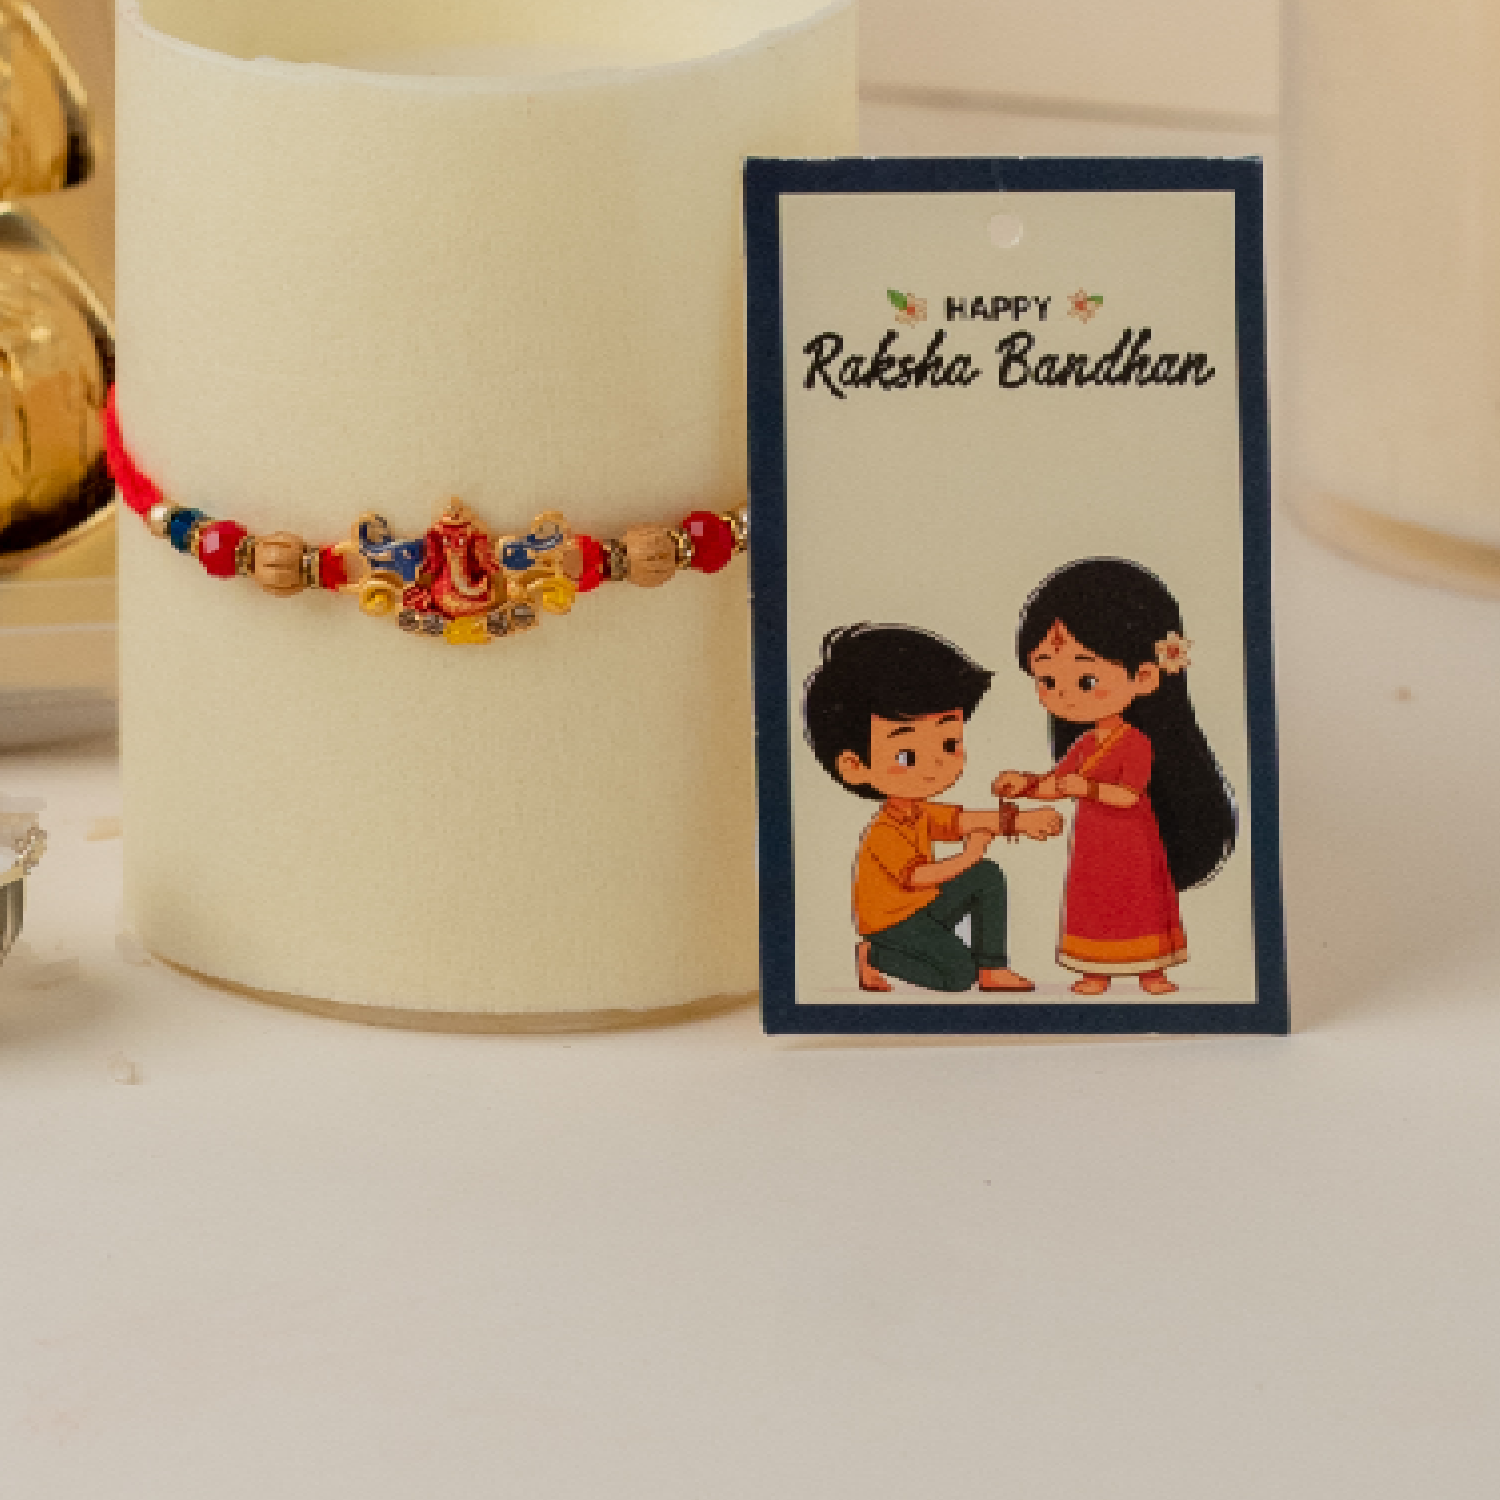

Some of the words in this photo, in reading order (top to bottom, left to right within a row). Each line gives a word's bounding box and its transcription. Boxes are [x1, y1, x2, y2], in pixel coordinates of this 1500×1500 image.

[946, 295, 1051, 322] HAPPY
[802, 328, 983, 399] Raksha
[996, 327, 1216, 388] Bandhan
